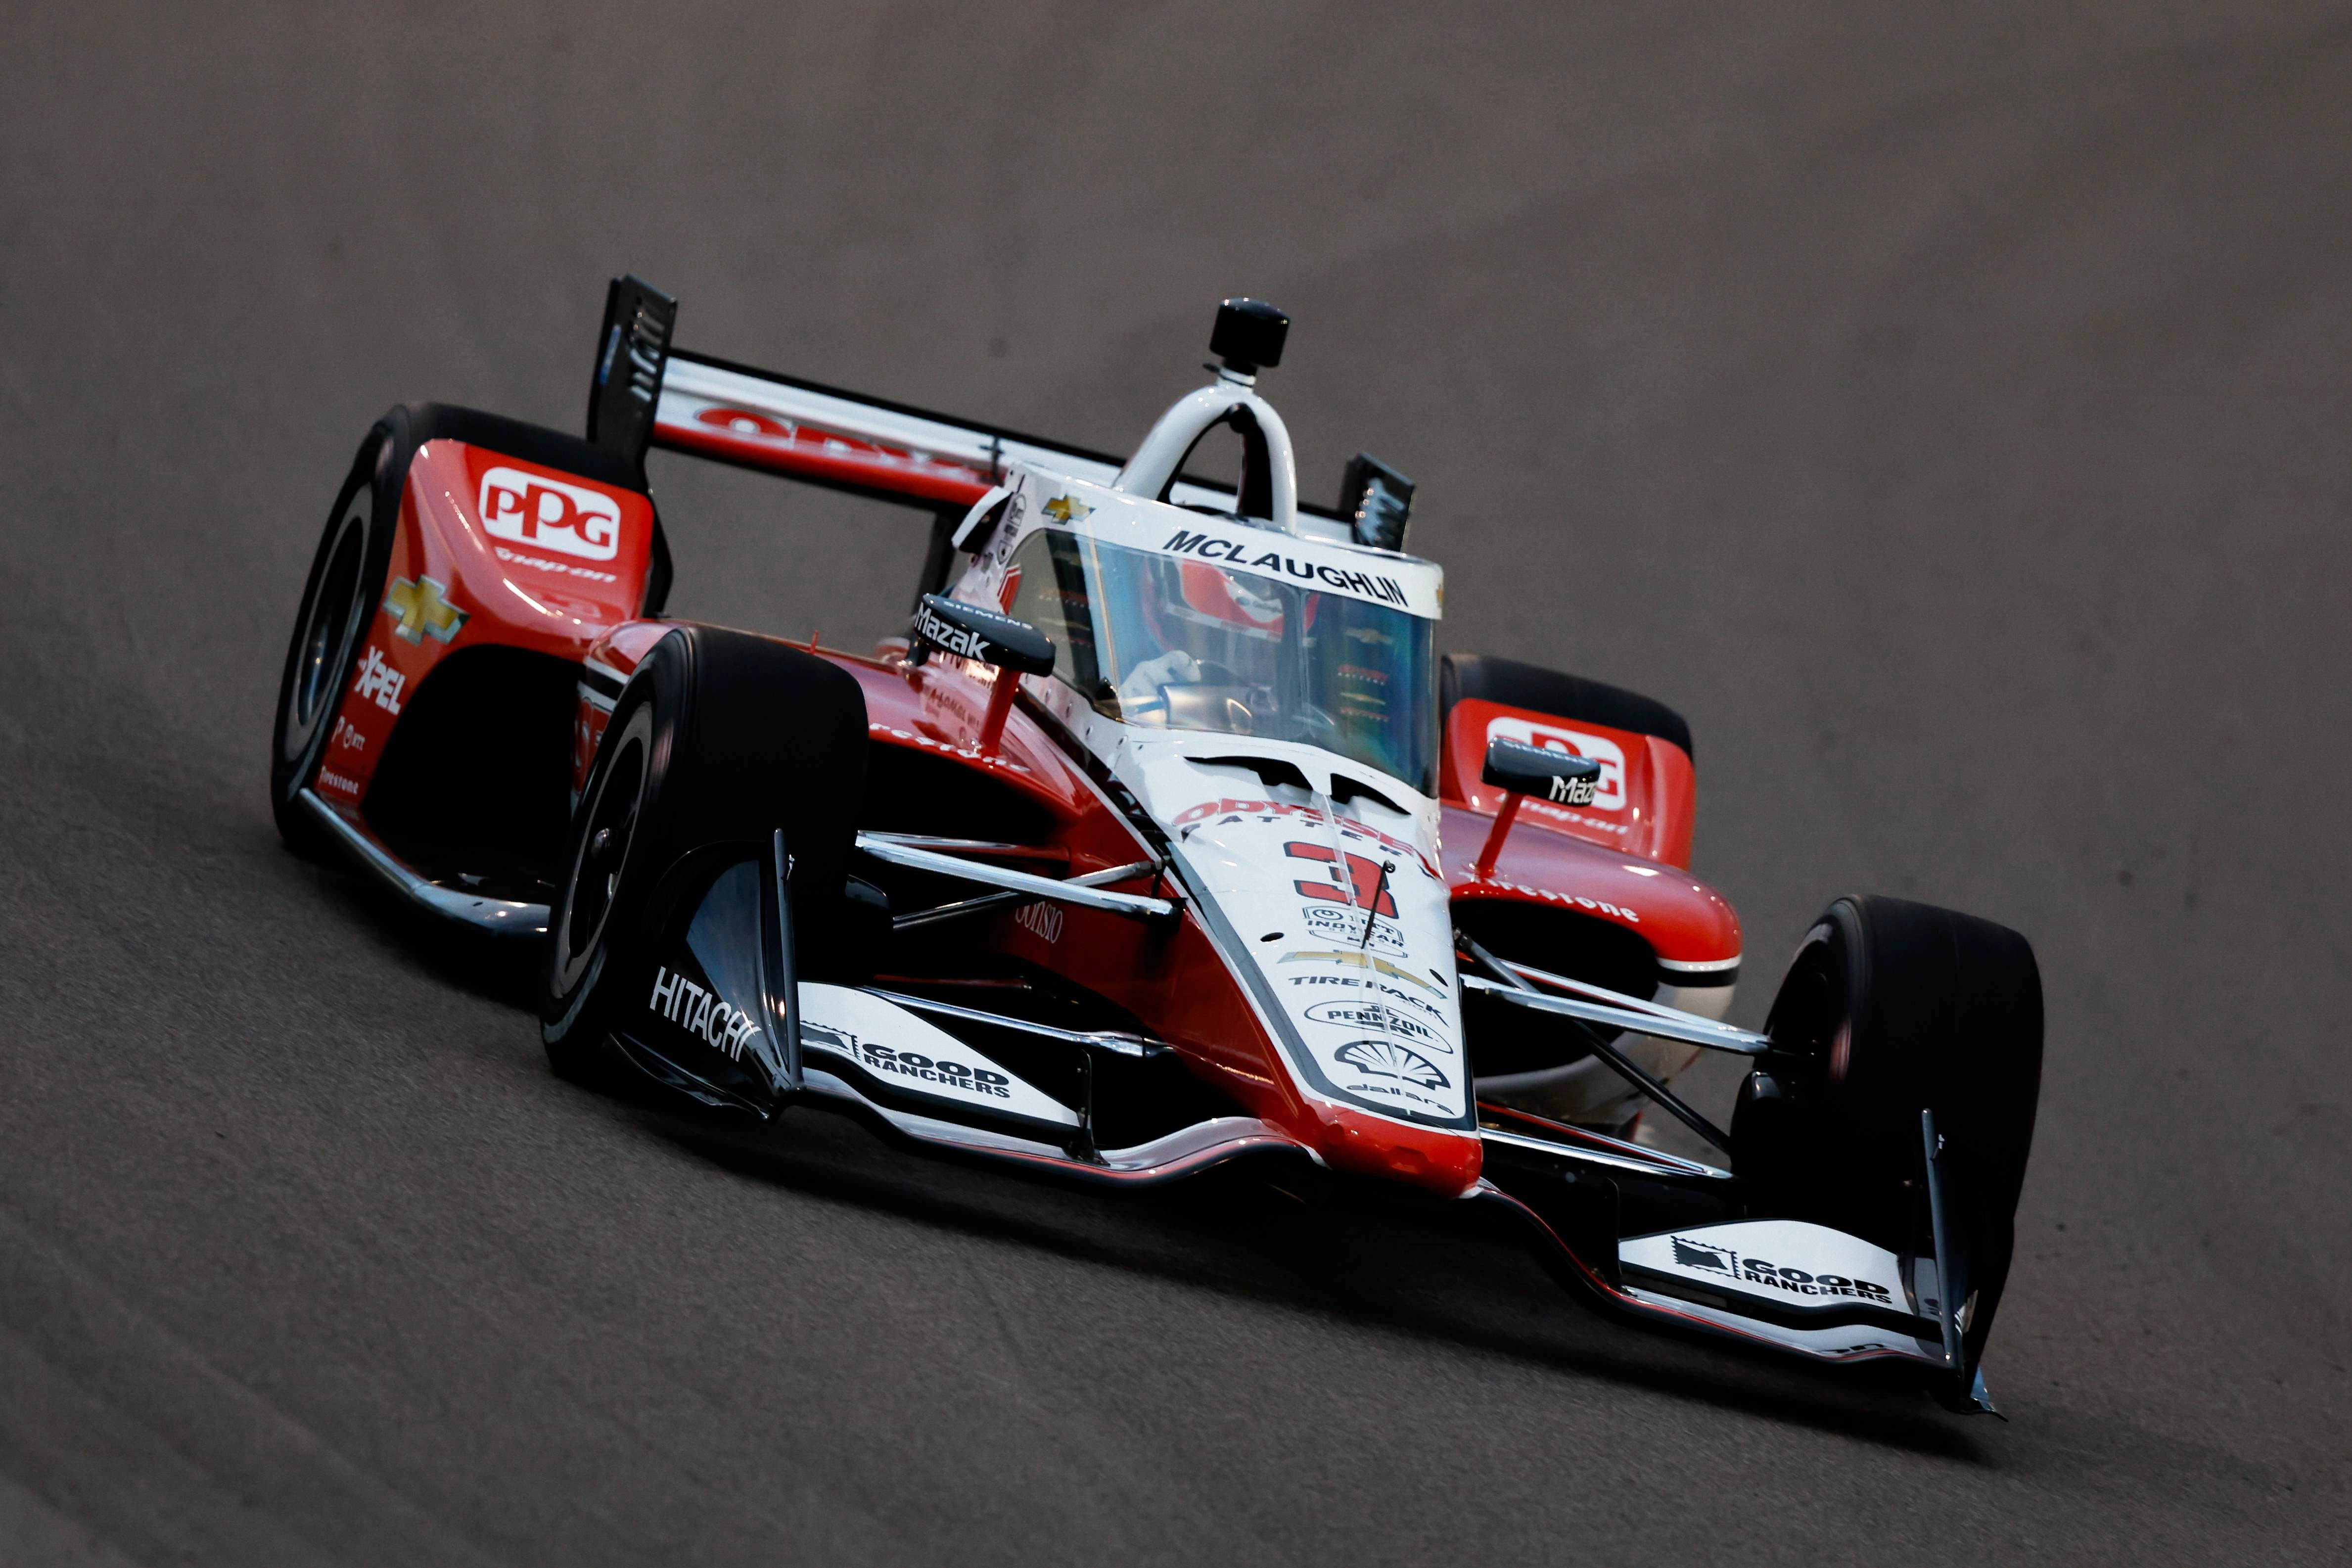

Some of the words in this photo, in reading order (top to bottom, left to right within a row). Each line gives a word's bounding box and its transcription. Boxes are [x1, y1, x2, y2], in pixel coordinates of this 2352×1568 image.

[485, 482, 612, 548] PPG
[1162, 530, 1409, 607] MCLAUGHLIN
[915, 601, 990, 661] Mazak
[943, 601, 1033, 630] SIEMENS
[354, 645, 407, 716] XPEL
[1548, 776, 1597, 804] Maz
[1283, 841, 1399, 919] 3
[1307, 920, 1404, 947] INDYAR
[649, 966, 762, 1062] HITACHI
[1288, 976, 1360, 986] TIRE
[1365, 981, 1450, 1028] RACK
[1327, 1011, 1433, 1039] PENNZOIL
[862, 1043, 1010, 1086] GOOD
[864, 1055, 1011, 1099] RANCHERS
[1346, 1084, 1456, 1116] dallara
[1742, 1258, 1890, 1294] GOOD
[1745, 1270, 1892, 1304] RANCHERS
